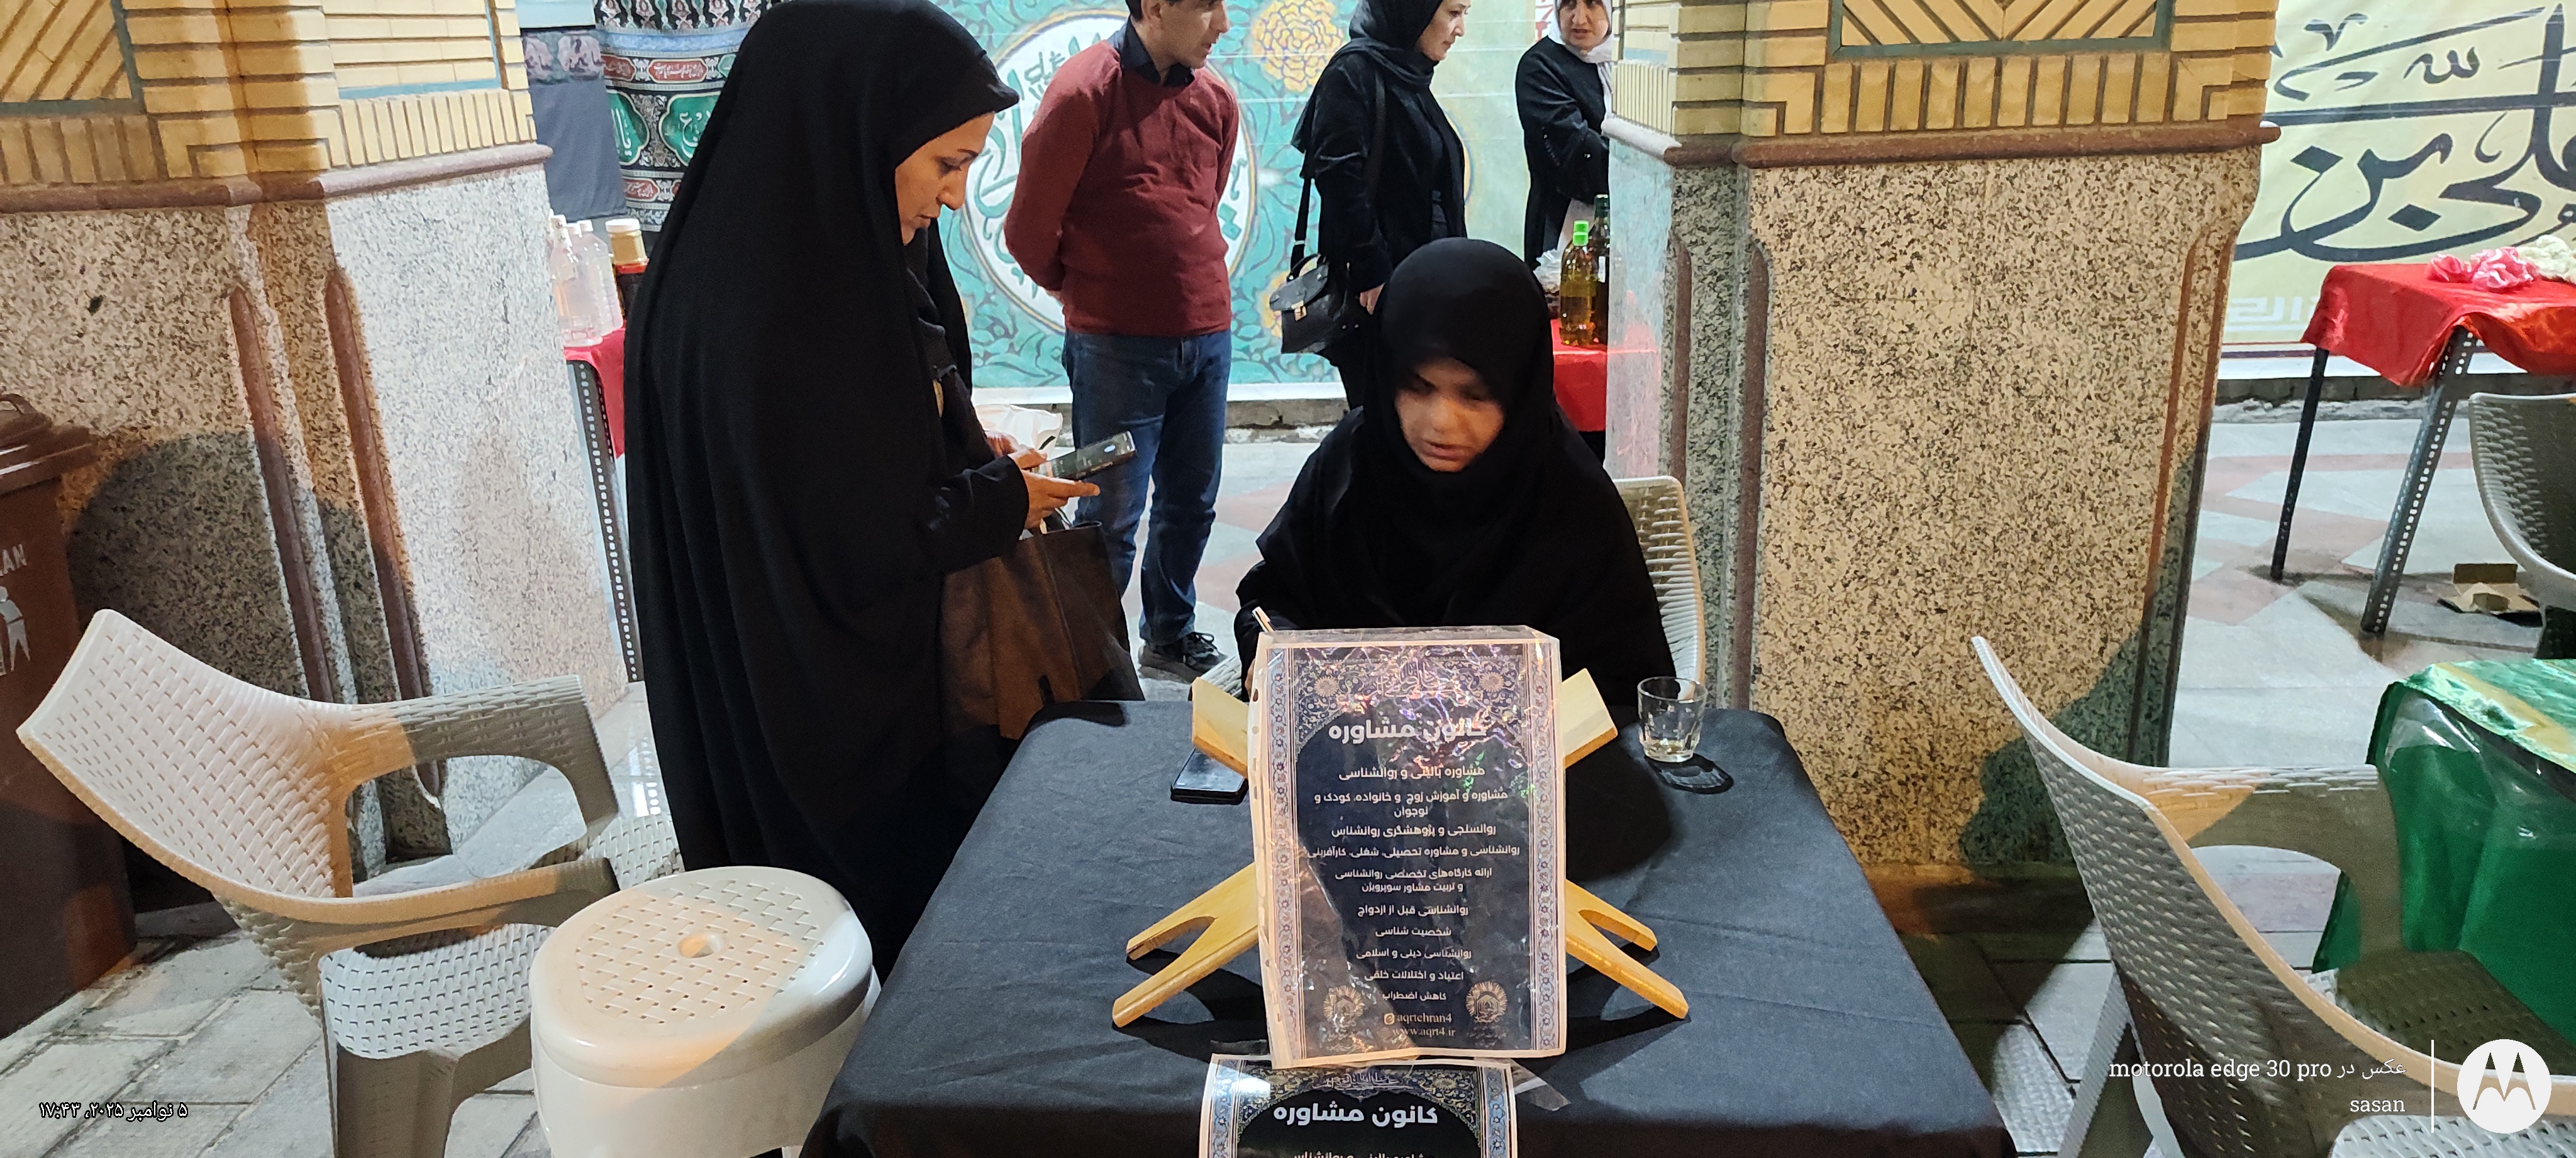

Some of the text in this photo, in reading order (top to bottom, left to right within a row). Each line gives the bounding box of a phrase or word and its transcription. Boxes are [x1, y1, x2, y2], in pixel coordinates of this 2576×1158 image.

[0, 543, 27, 576] AN
[1329, 716, 1415, 744] مشاوره
[1338, 766, 1485, 781] مشاوره بالینی و روانشناسی
[1314, 794, 1321, 804] و
[1323, 792, 1351, 803] کودک
[1394, 794, 1401, 803] و
[1406, 791, 1423, 804] زوج
[1426, 788, 1460, 802] آموزش
[1462, 793, 1469, 802] و
[1471, 790, 1508, 802] مشاوره
[1394, 806, 1428, 818] نوجوان
[1331, 824, 1496, 838] روانسنجی و پژوهشگری روانشناس
[1424, 846, 1459, 858] مشاوره
[1461, 847, 1468, 856] و
[1469, 844, 1520, 856] روانشناسی
[1335, 868, 1382, 880] روانشناسی
[1385, 868, 1426, 880] تخصصی
[1474, 868, 1492, 878] ارائه
[1403, 882, 1431, 893] مشاور
[1433, 881, 1455, 891] تربیت
[1457, 883, 1463, 892] و
[1358, 905, 1469, 917] روانشناسی قبل از ازدواج
[1375, 926, 1452, 937] شخصیت شناسی
[1356, 948, 1472, 959] روانشناسی دینی و اسلامی
[1364, 969, 1463, 981] اعتیاد و اختلالات خلقی
[1382, 991, 1446, 1001] کاهش اضطراب
[1273, 1101, 1438, 1128] کانون مشاوره
